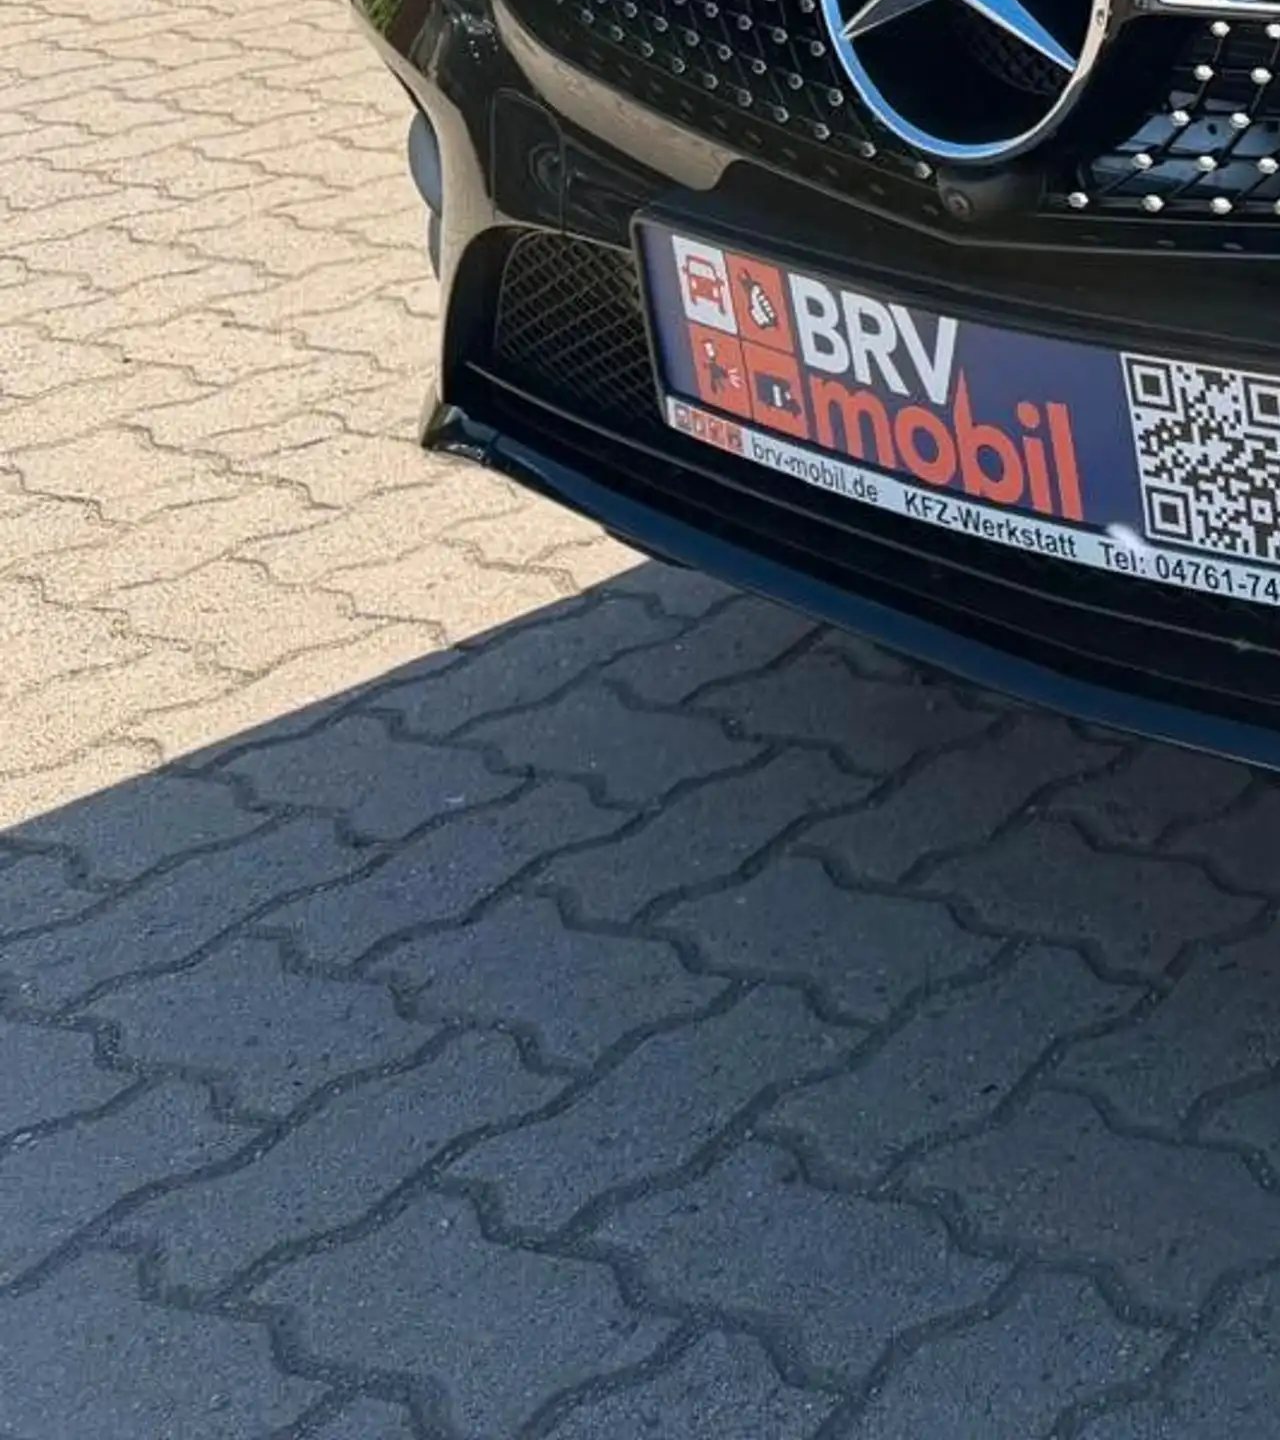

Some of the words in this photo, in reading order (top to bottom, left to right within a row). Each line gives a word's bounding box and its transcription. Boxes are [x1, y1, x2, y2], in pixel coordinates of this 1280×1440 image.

[787, 272, 959, 405] BRV
[751, 435, 879, 503] brv-mobil.de
[903, 489, 1077, 558] KFZ-Werkstatt
[1098, 540, 1146, 575] Tel:
[809, 366, 1084, 522] mobil
